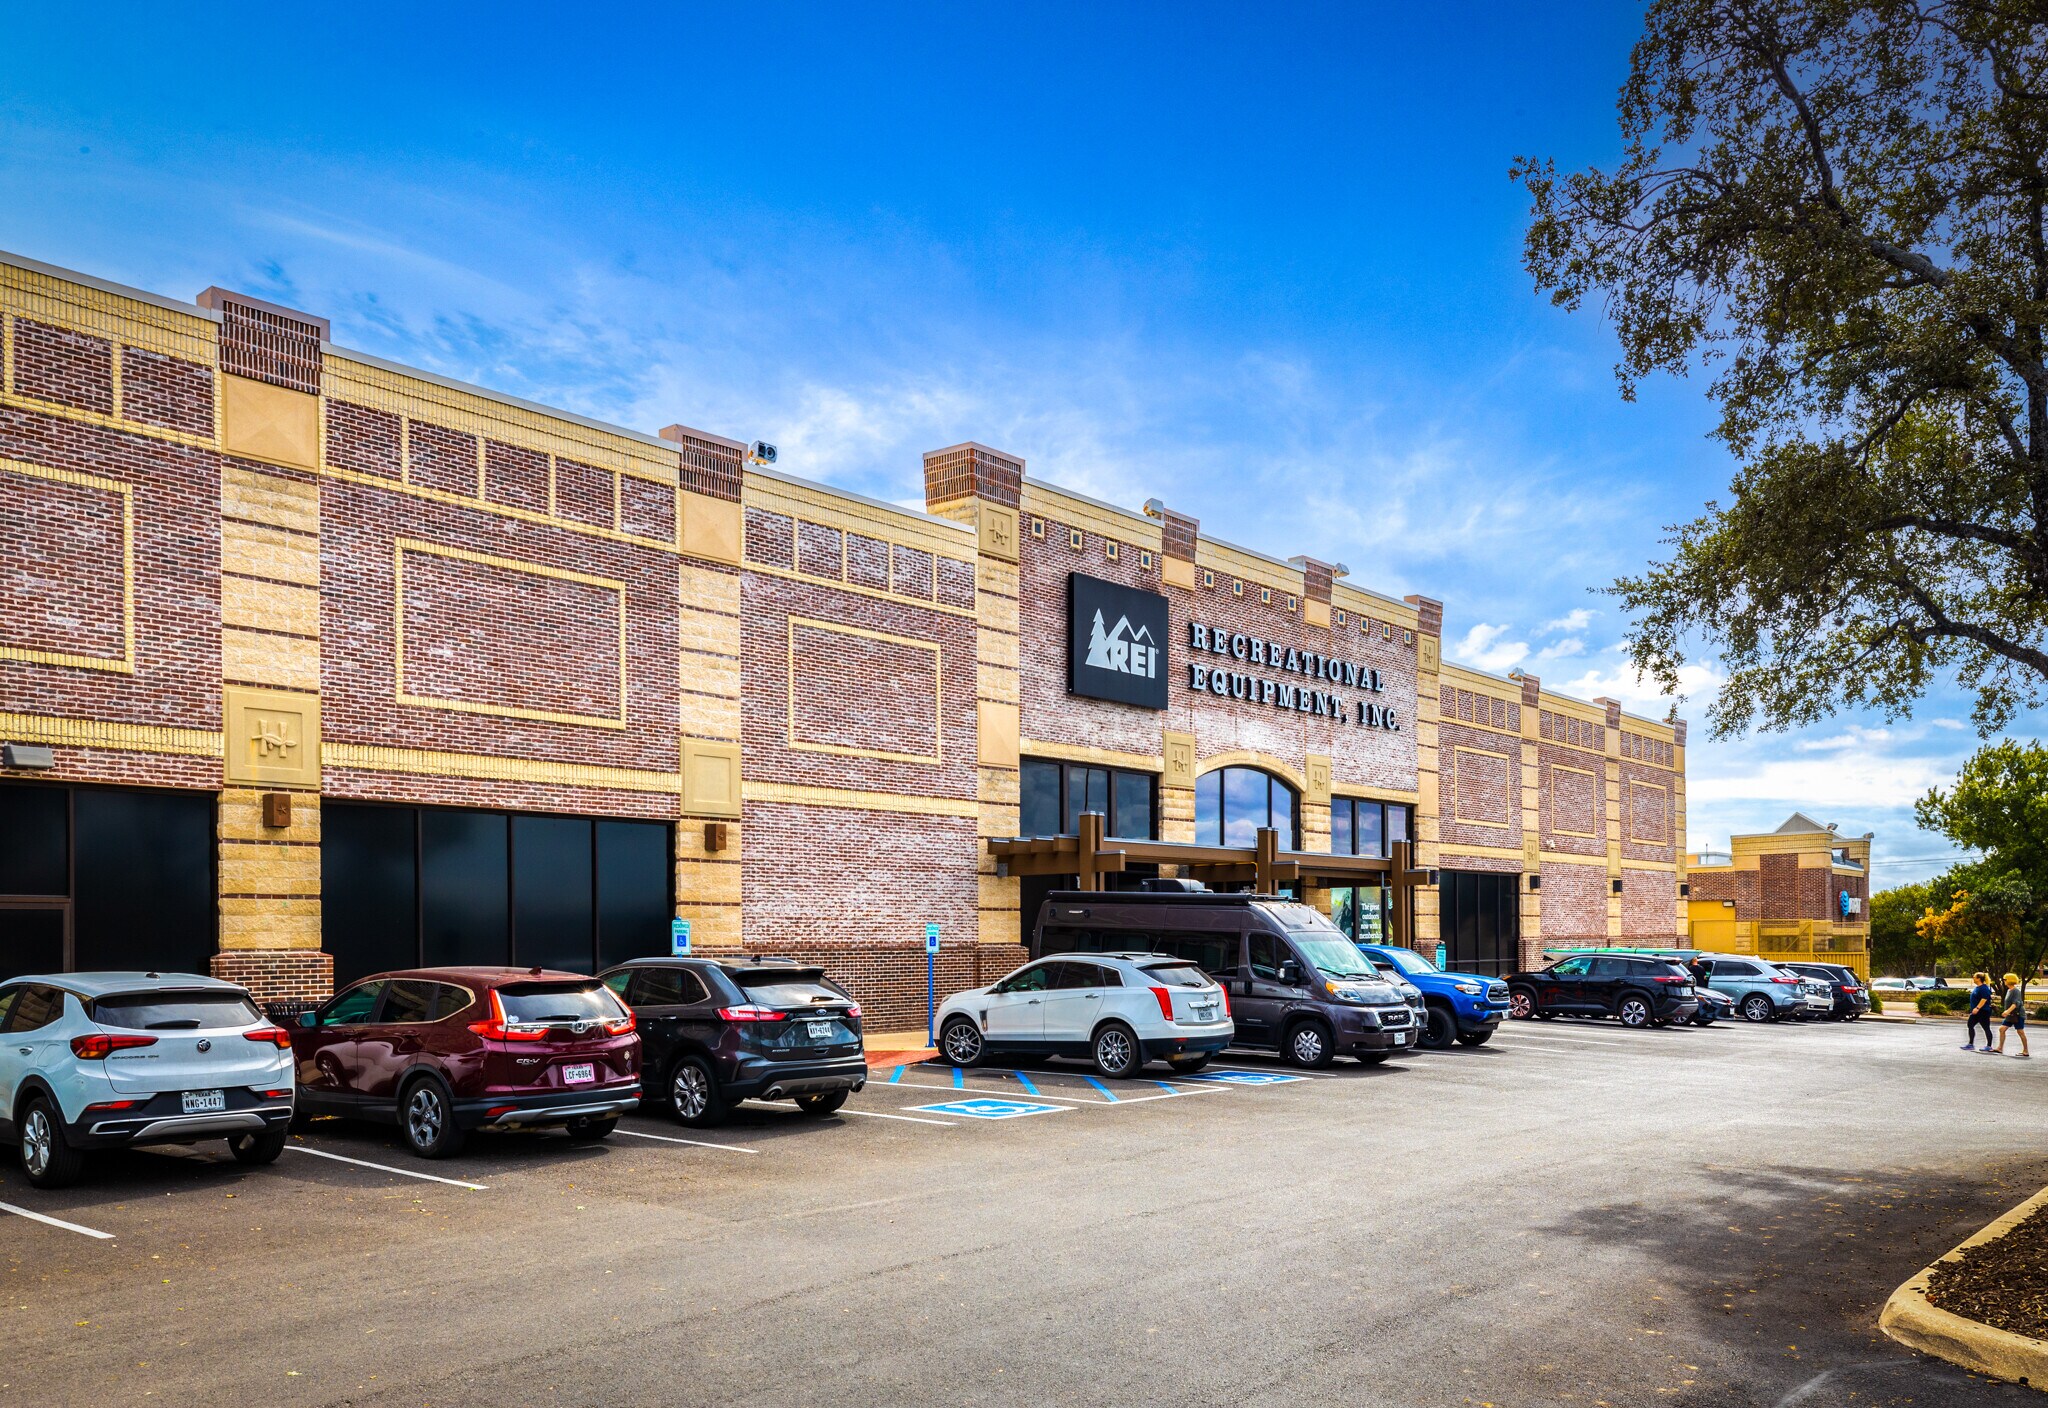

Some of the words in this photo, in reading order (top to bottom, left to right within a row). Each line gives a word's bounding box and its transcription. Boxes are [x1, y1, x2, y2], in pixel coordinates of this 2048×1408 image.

[1109, 637, 1156, 679] REI
[1190, 622, 1385, 692] RECREATIONAL
[1190, 664, 1349, 723] EQUIPMENT,
[1359, 701, 1402, 730] INC.
[185, 1097, 222, 1109] NNG-1447
